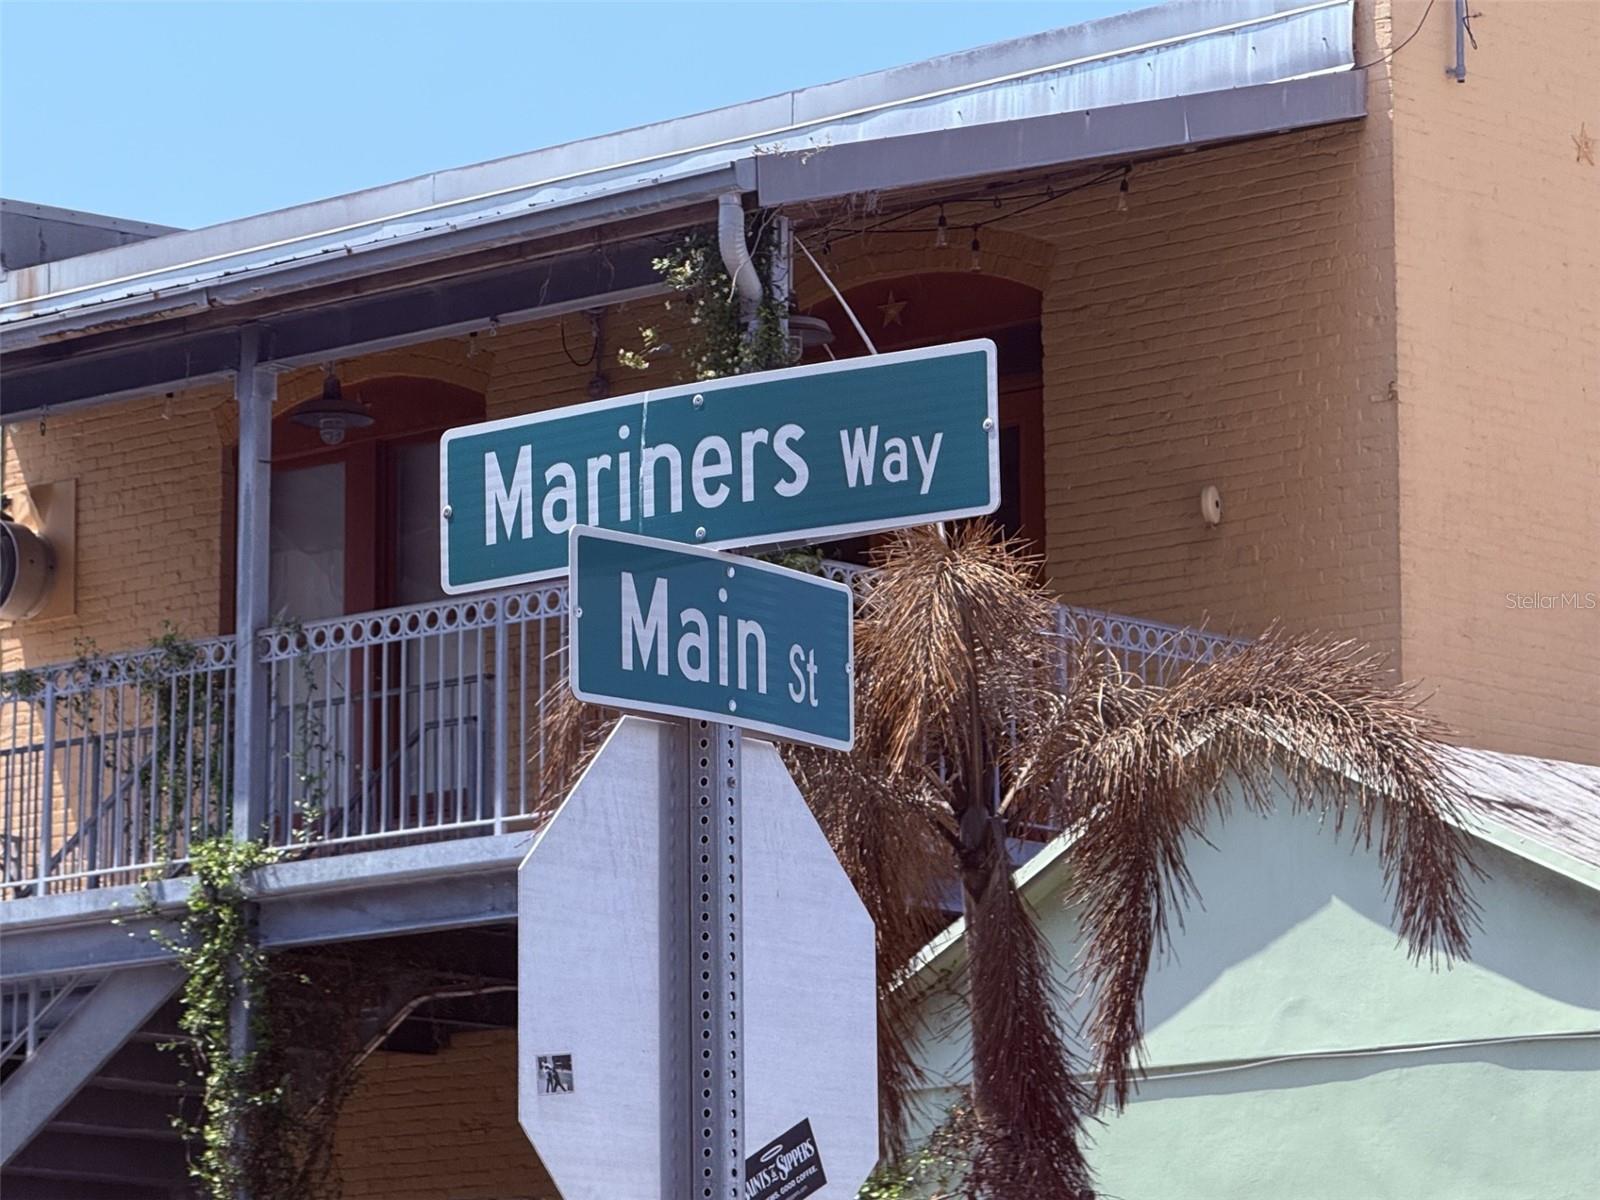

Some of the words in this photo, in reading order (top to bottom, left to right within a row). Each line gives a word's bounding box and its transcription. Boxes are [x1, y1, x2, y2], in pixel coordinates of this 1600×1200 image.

[484, 423, 809, 546] Mariners
[839, 424, 944, 495] Way
[620, 572, 768, 695] Main
[788, 643, 820, 708] St
[776, 1138, 815, 1181] SIPPERS
